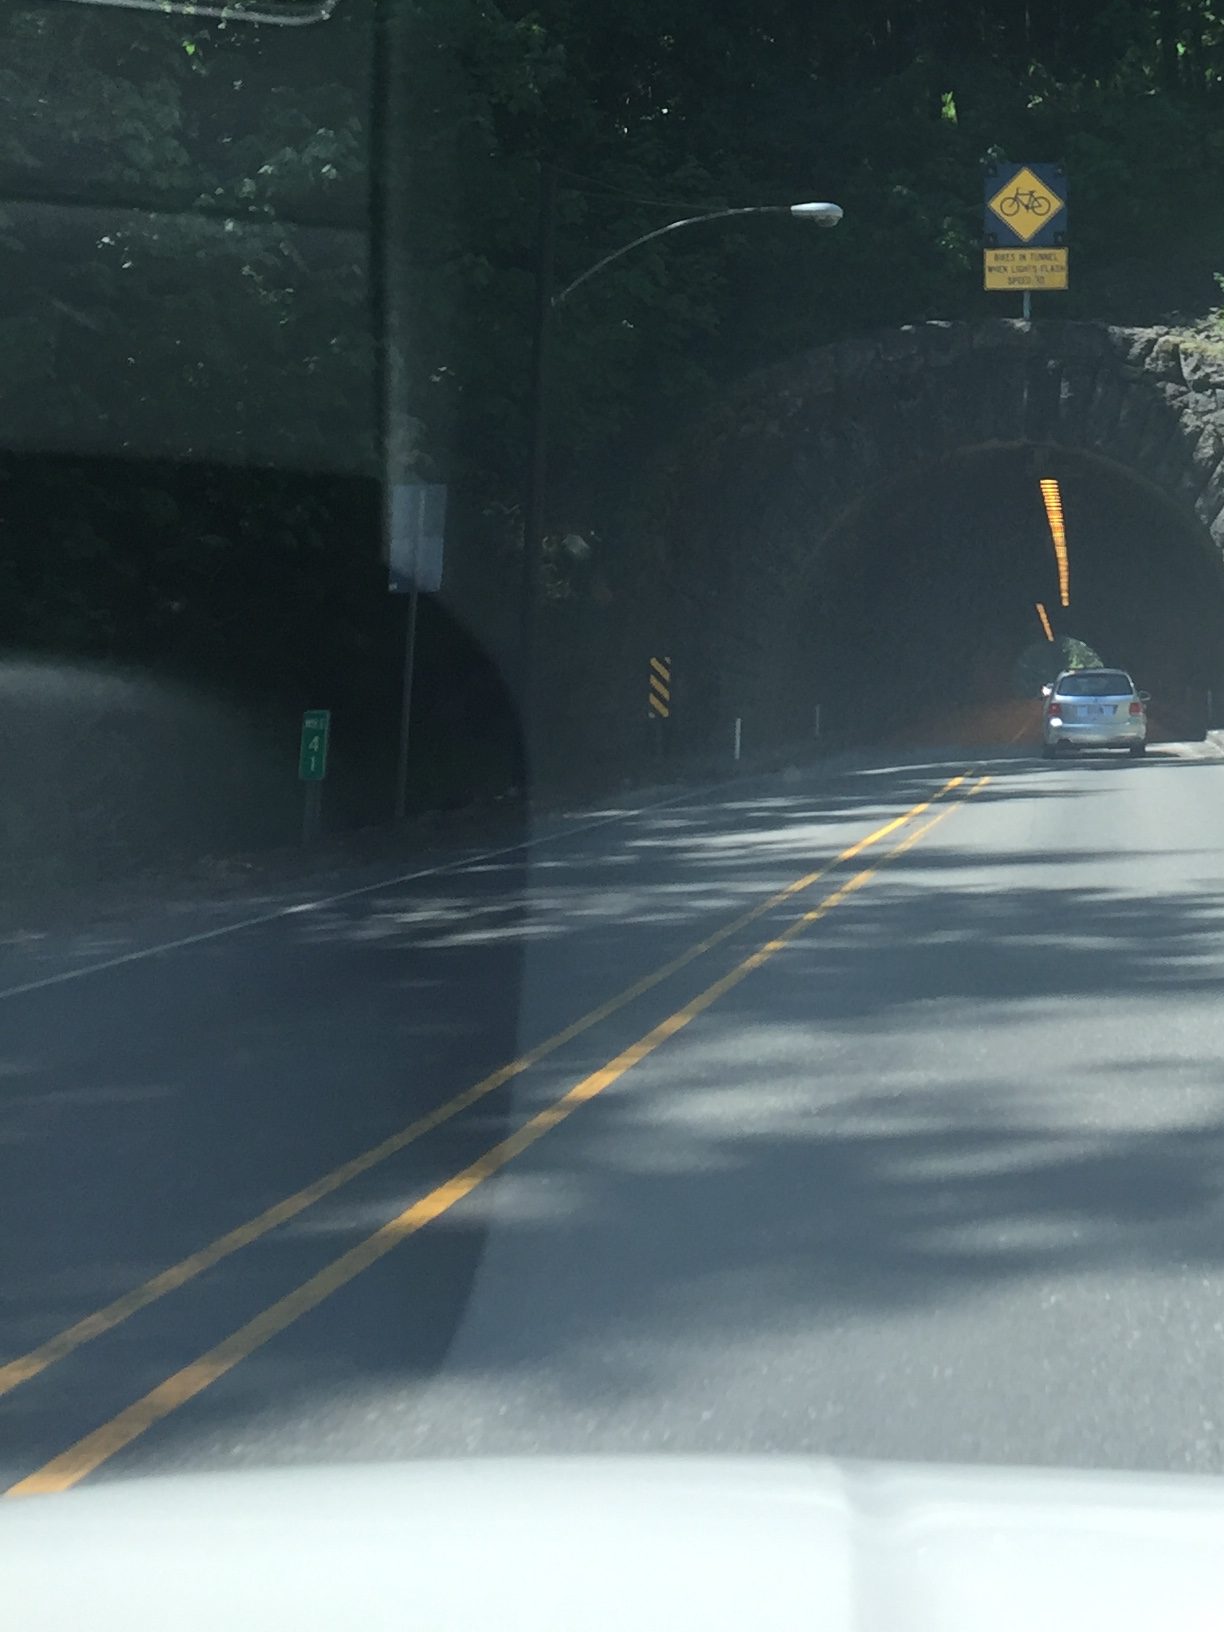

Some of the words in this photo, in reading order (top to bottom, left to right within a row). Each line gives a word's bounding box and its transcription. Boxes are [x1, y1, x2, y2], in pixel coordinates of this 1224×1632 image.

[994, 253, 1015, 262] BIKES
[1019, 253, 1026, 262] IN
[1030, 253, 1057, 262] TUNNEL
[988, 265, 1007, 273] WHEN
[1011, 265, 1037, 273] LIGHTS
